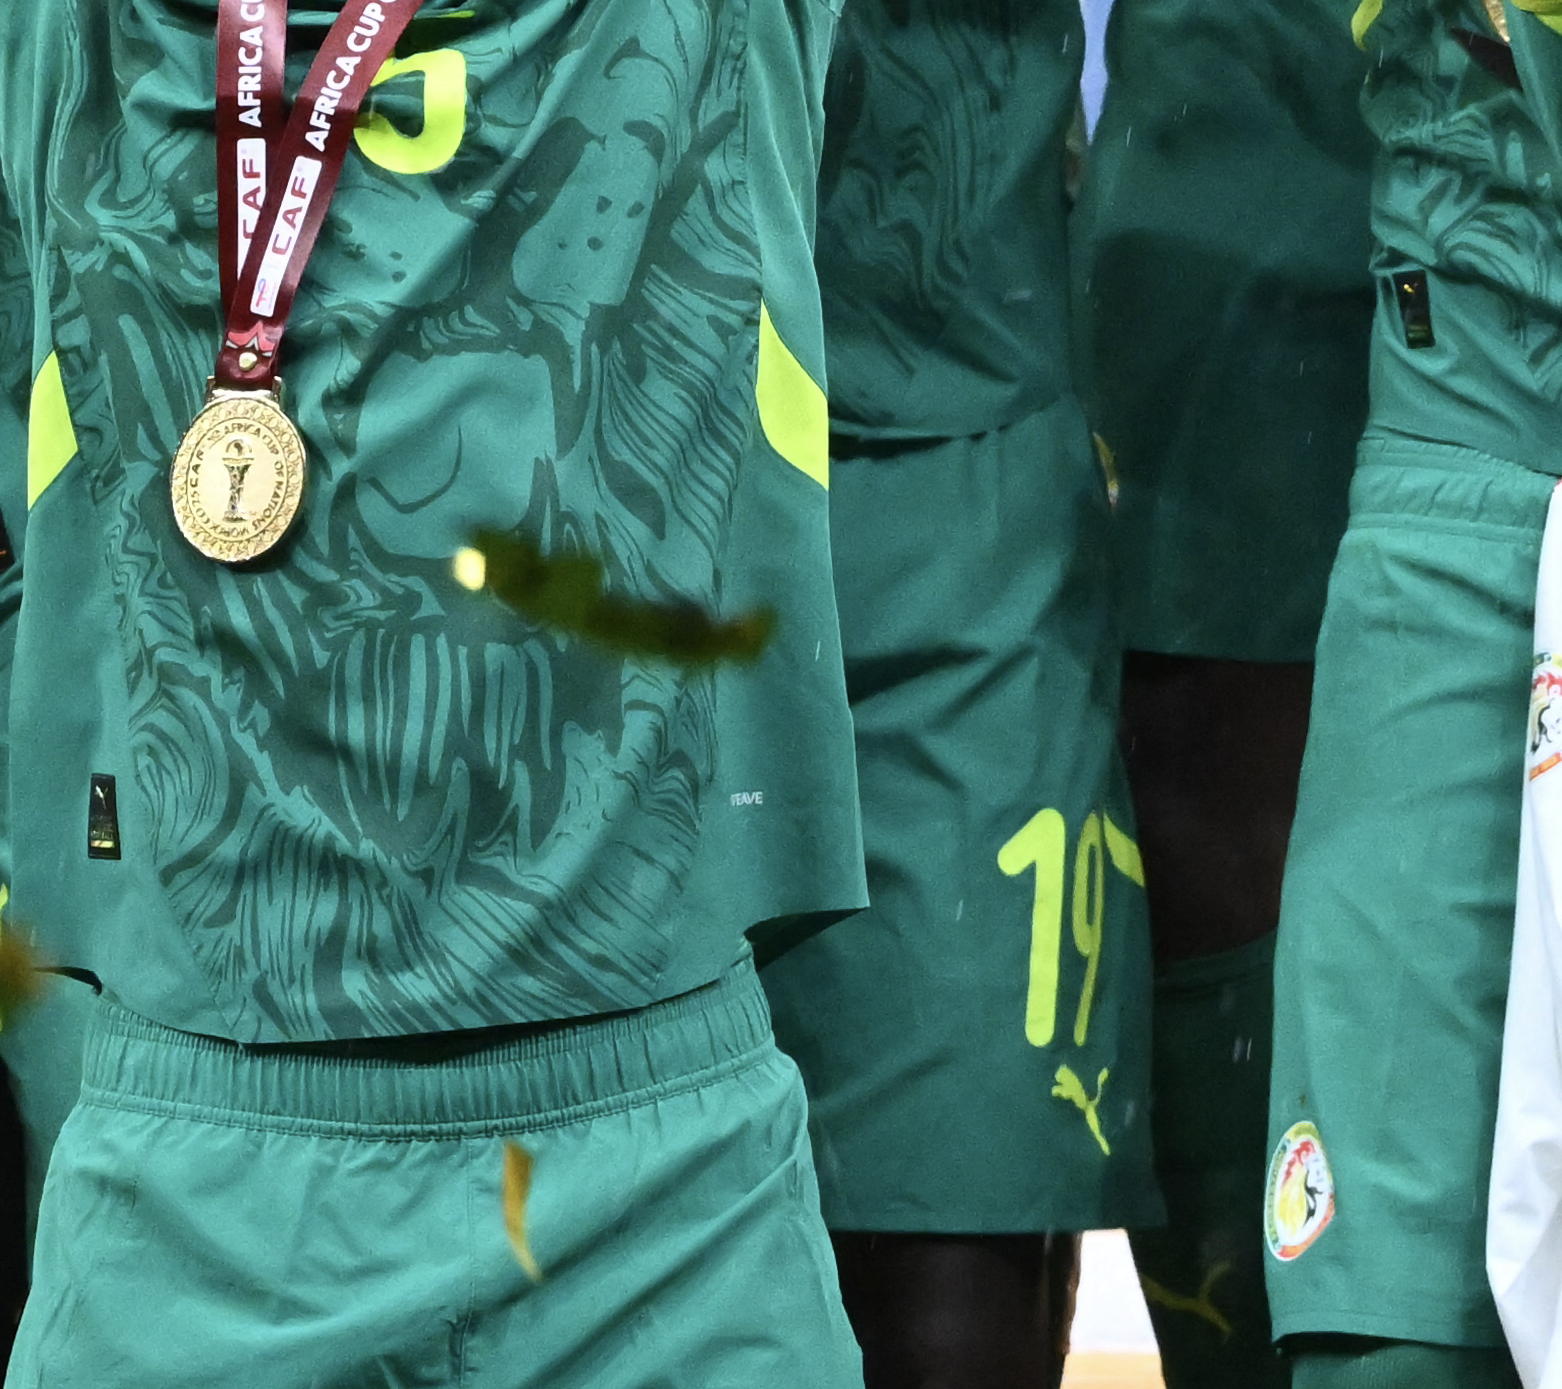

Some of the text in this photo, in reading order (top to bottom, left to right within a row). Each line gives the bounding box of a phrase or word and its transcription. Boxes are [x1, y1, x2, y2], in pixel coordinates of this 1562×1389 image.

[237, 25, 264, 128] AFRICA
[305, 55, 363, 153] AFRICA
[346, 0, 388, 56] CUP
[271, 175, 307, 257] CAF
